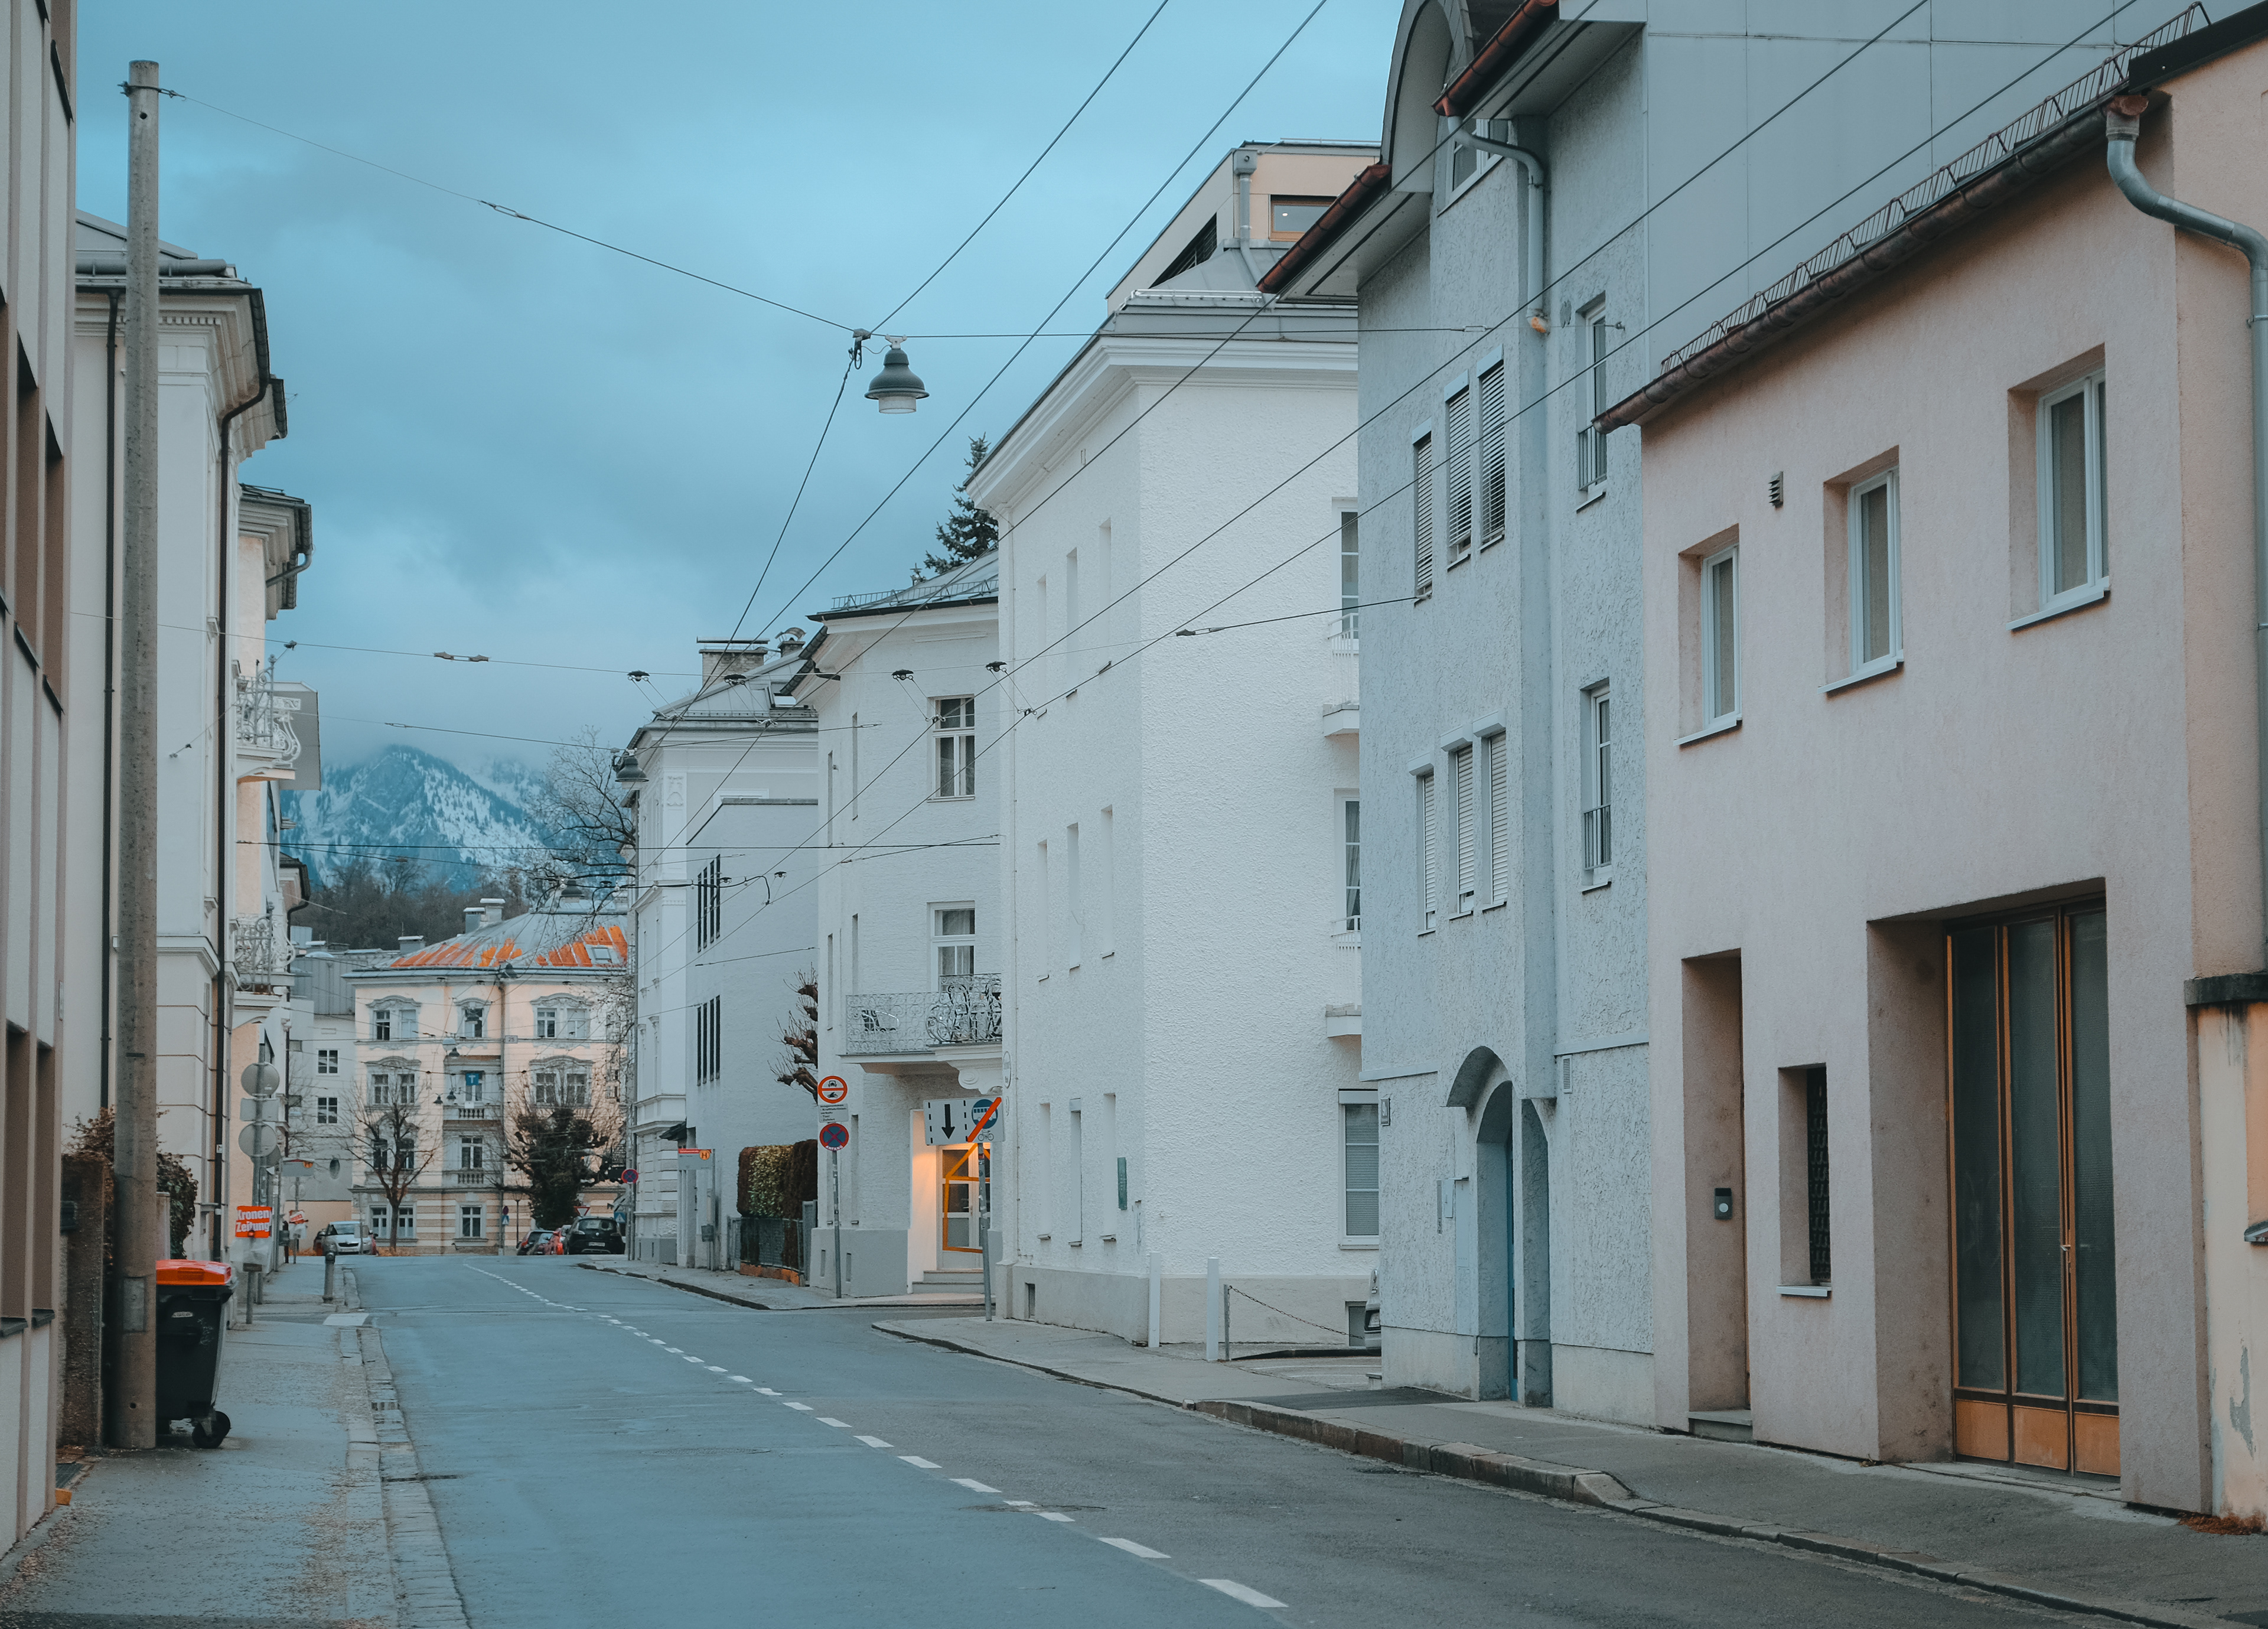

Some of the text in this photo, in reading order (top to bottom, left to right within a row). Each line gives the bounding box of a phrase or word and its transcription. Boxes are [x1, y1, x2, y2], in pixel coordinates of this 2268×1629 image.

[468, 1075, 476, 1083] T
[237, 1210, 269, 1220] Kronen
[236, 1221, 270, 1232] Zeitung
